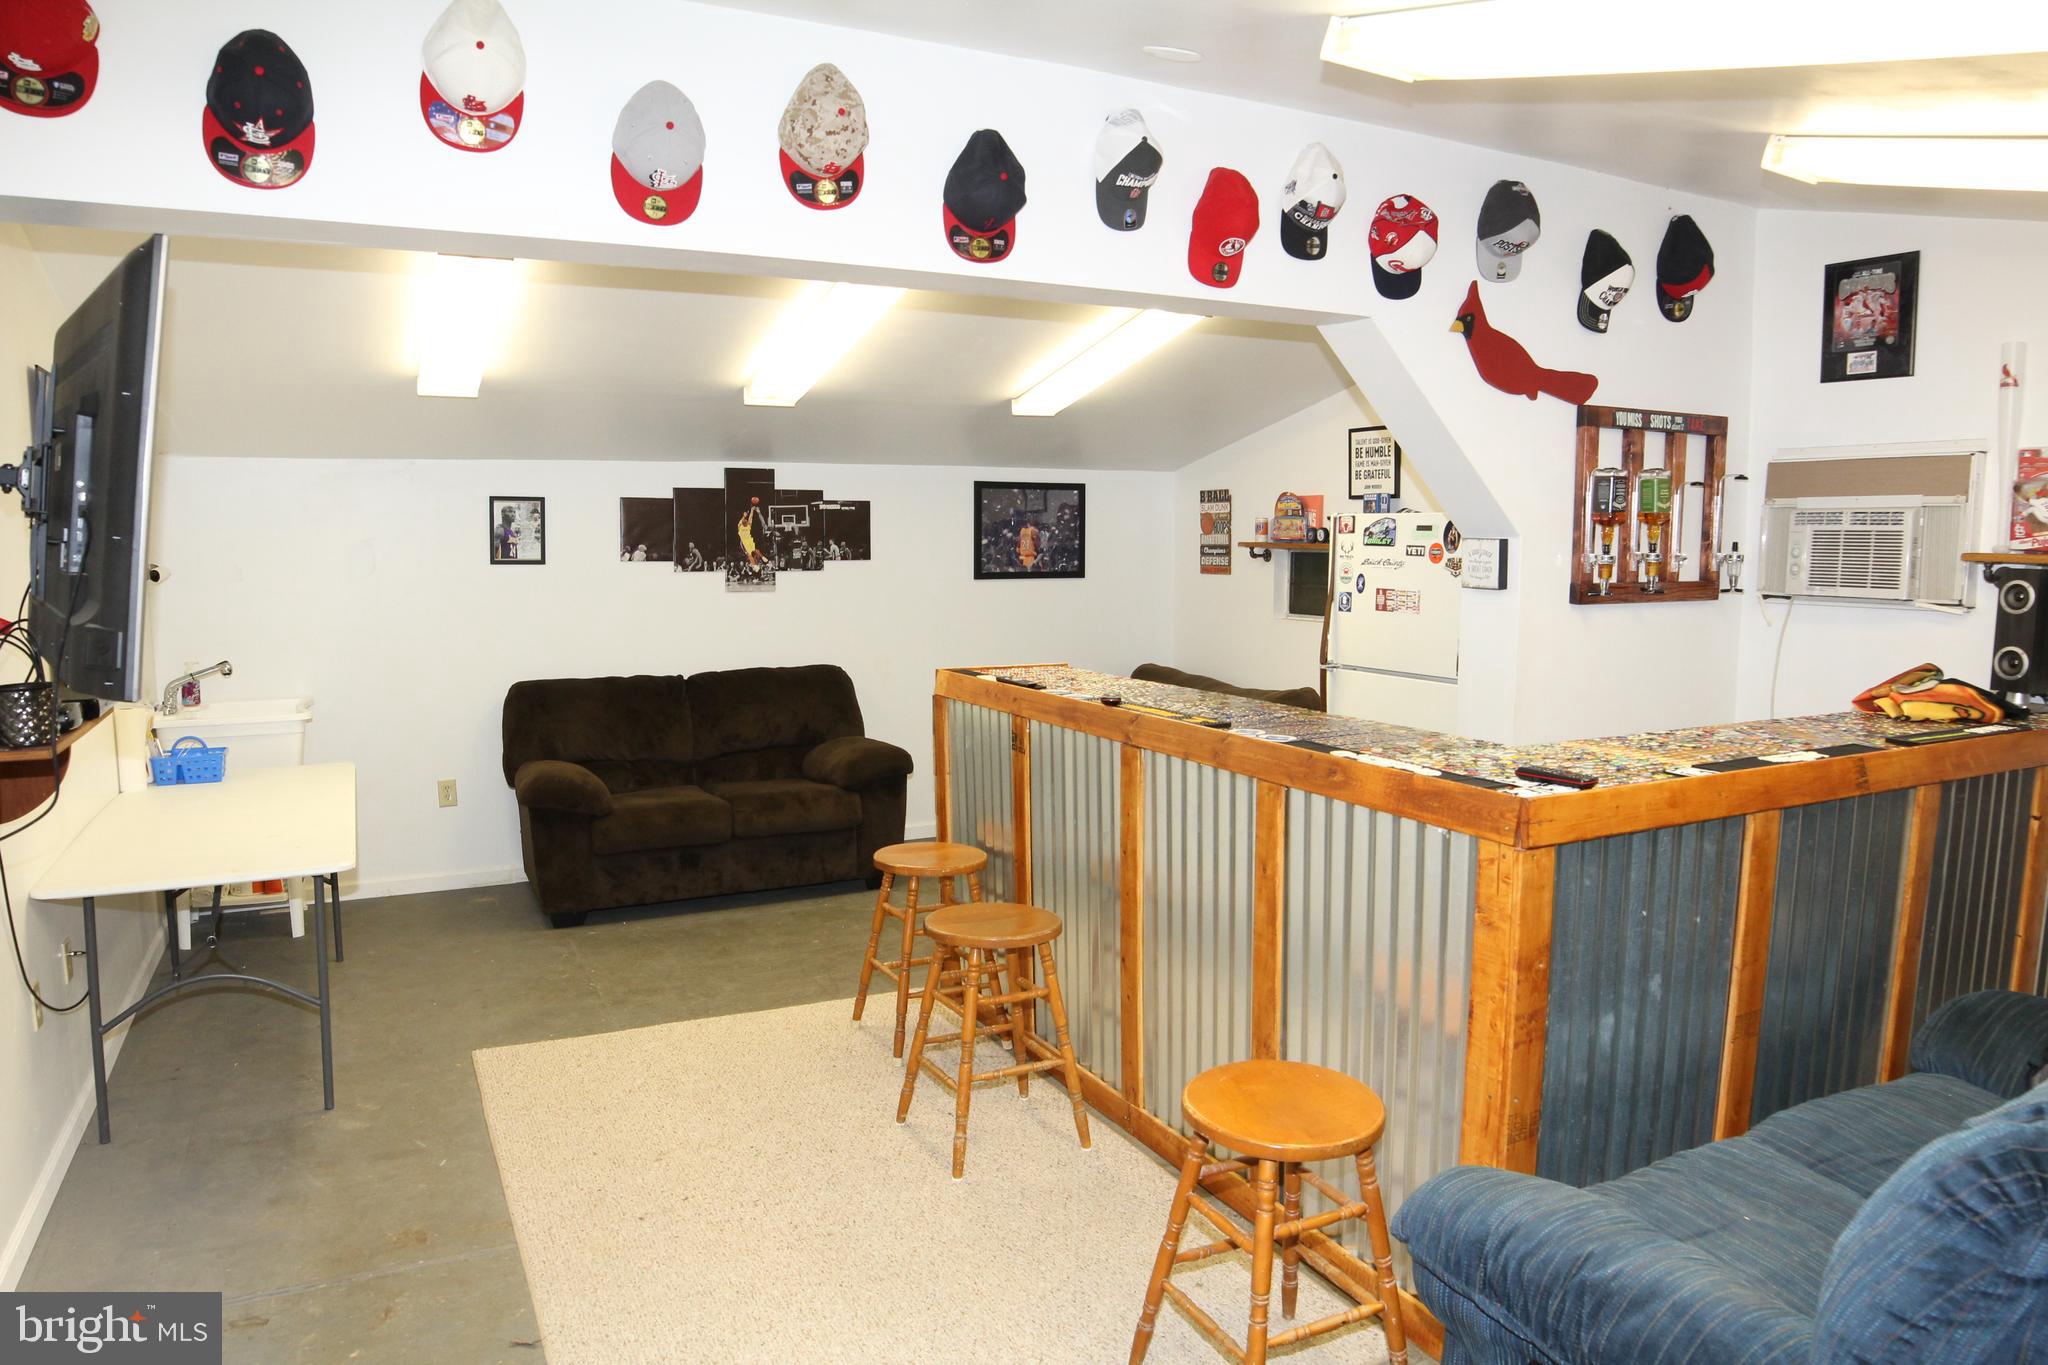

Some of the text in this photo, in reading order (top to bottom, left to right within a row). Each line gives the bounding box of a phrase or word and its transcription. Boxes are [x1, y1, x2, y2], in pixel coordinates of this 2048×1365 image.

[1650, 414, 1671, 429] SHOTS
[1355, 445, 1391, 459] BE HUMBLE
[1355, 469, 1391, 480] BE GRATEFUL
[1407, 546, 1425, 556] YETI
[1201, 557, 1229, 566] DEFENSE
